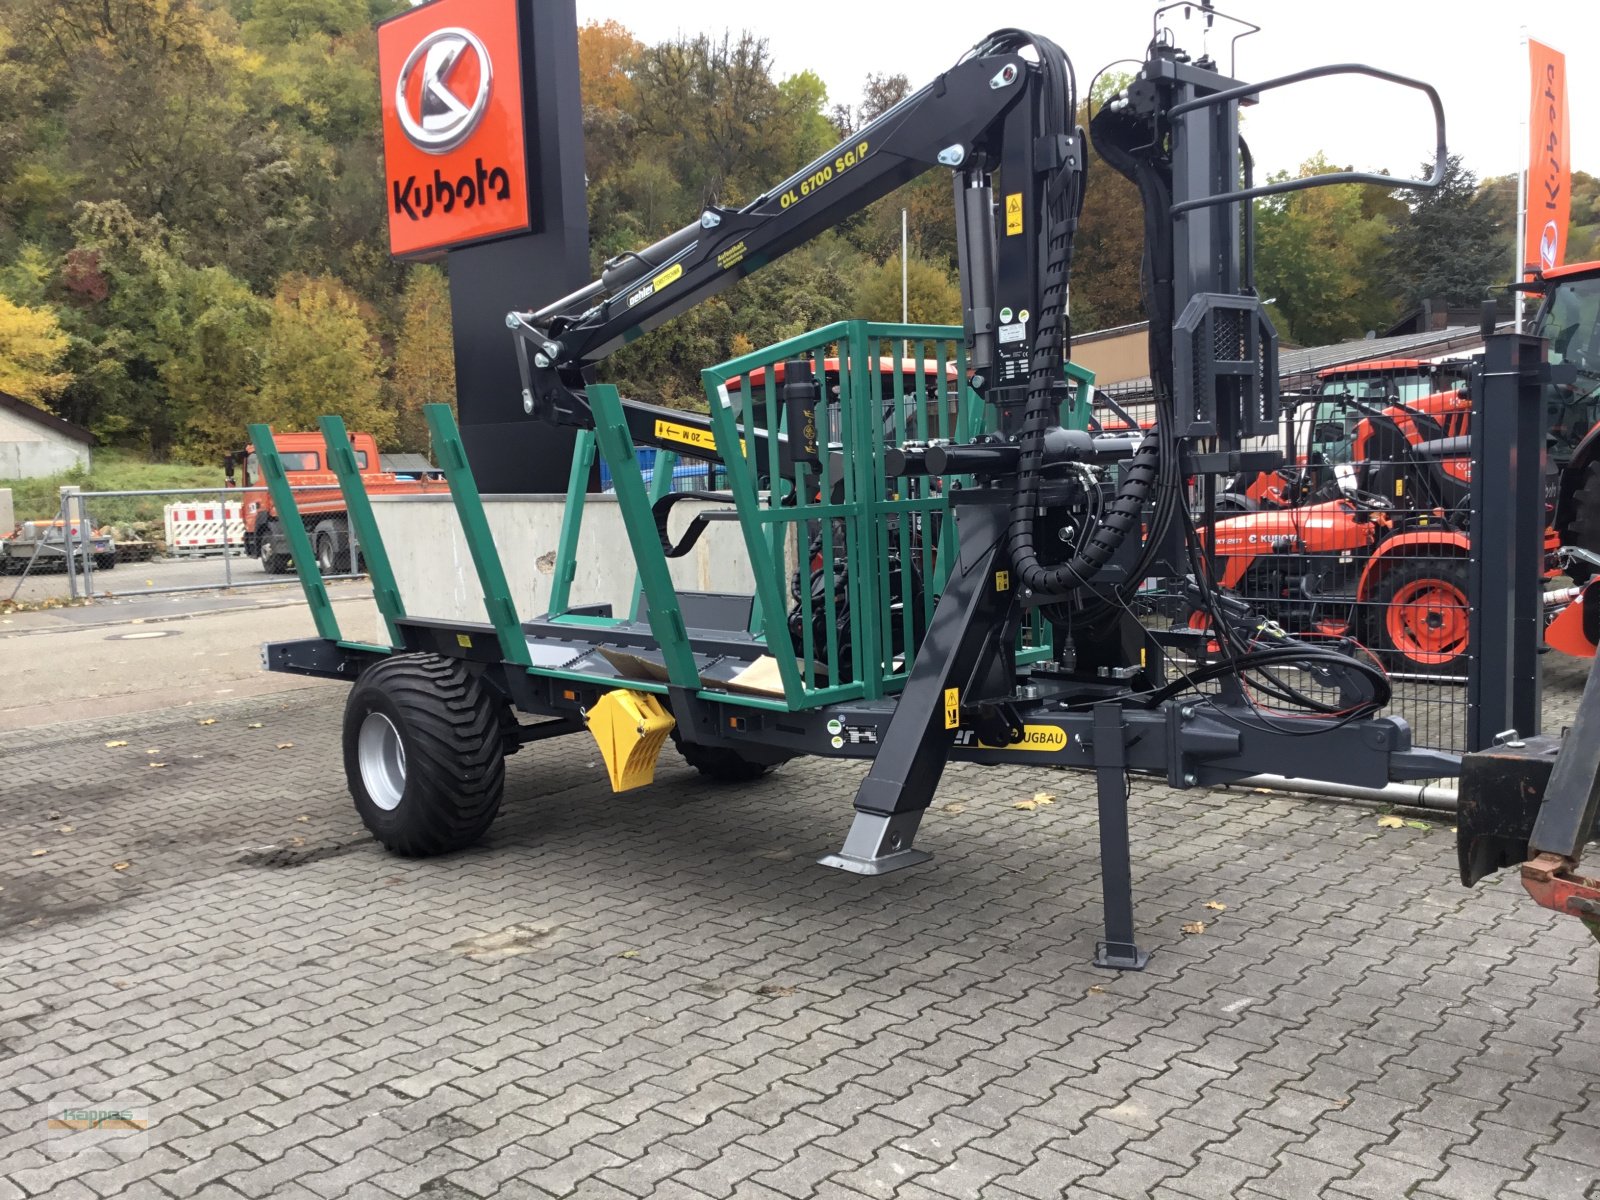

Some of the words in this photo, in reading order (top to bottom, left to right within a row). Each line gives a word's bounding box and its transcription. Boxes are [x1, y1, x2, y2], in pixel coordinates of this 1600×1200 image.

[1545, 63, 1561, 210] Kubota
[394, 157, 510, 221] Kubota
[780, 190, 799, 209] OL
[800, 166, 832, 195] 6700
[835, 142, 869, 173] SG/P
[691, 432, 701, 442] 20
[1022, 732, 1064, 745] UGBAU
